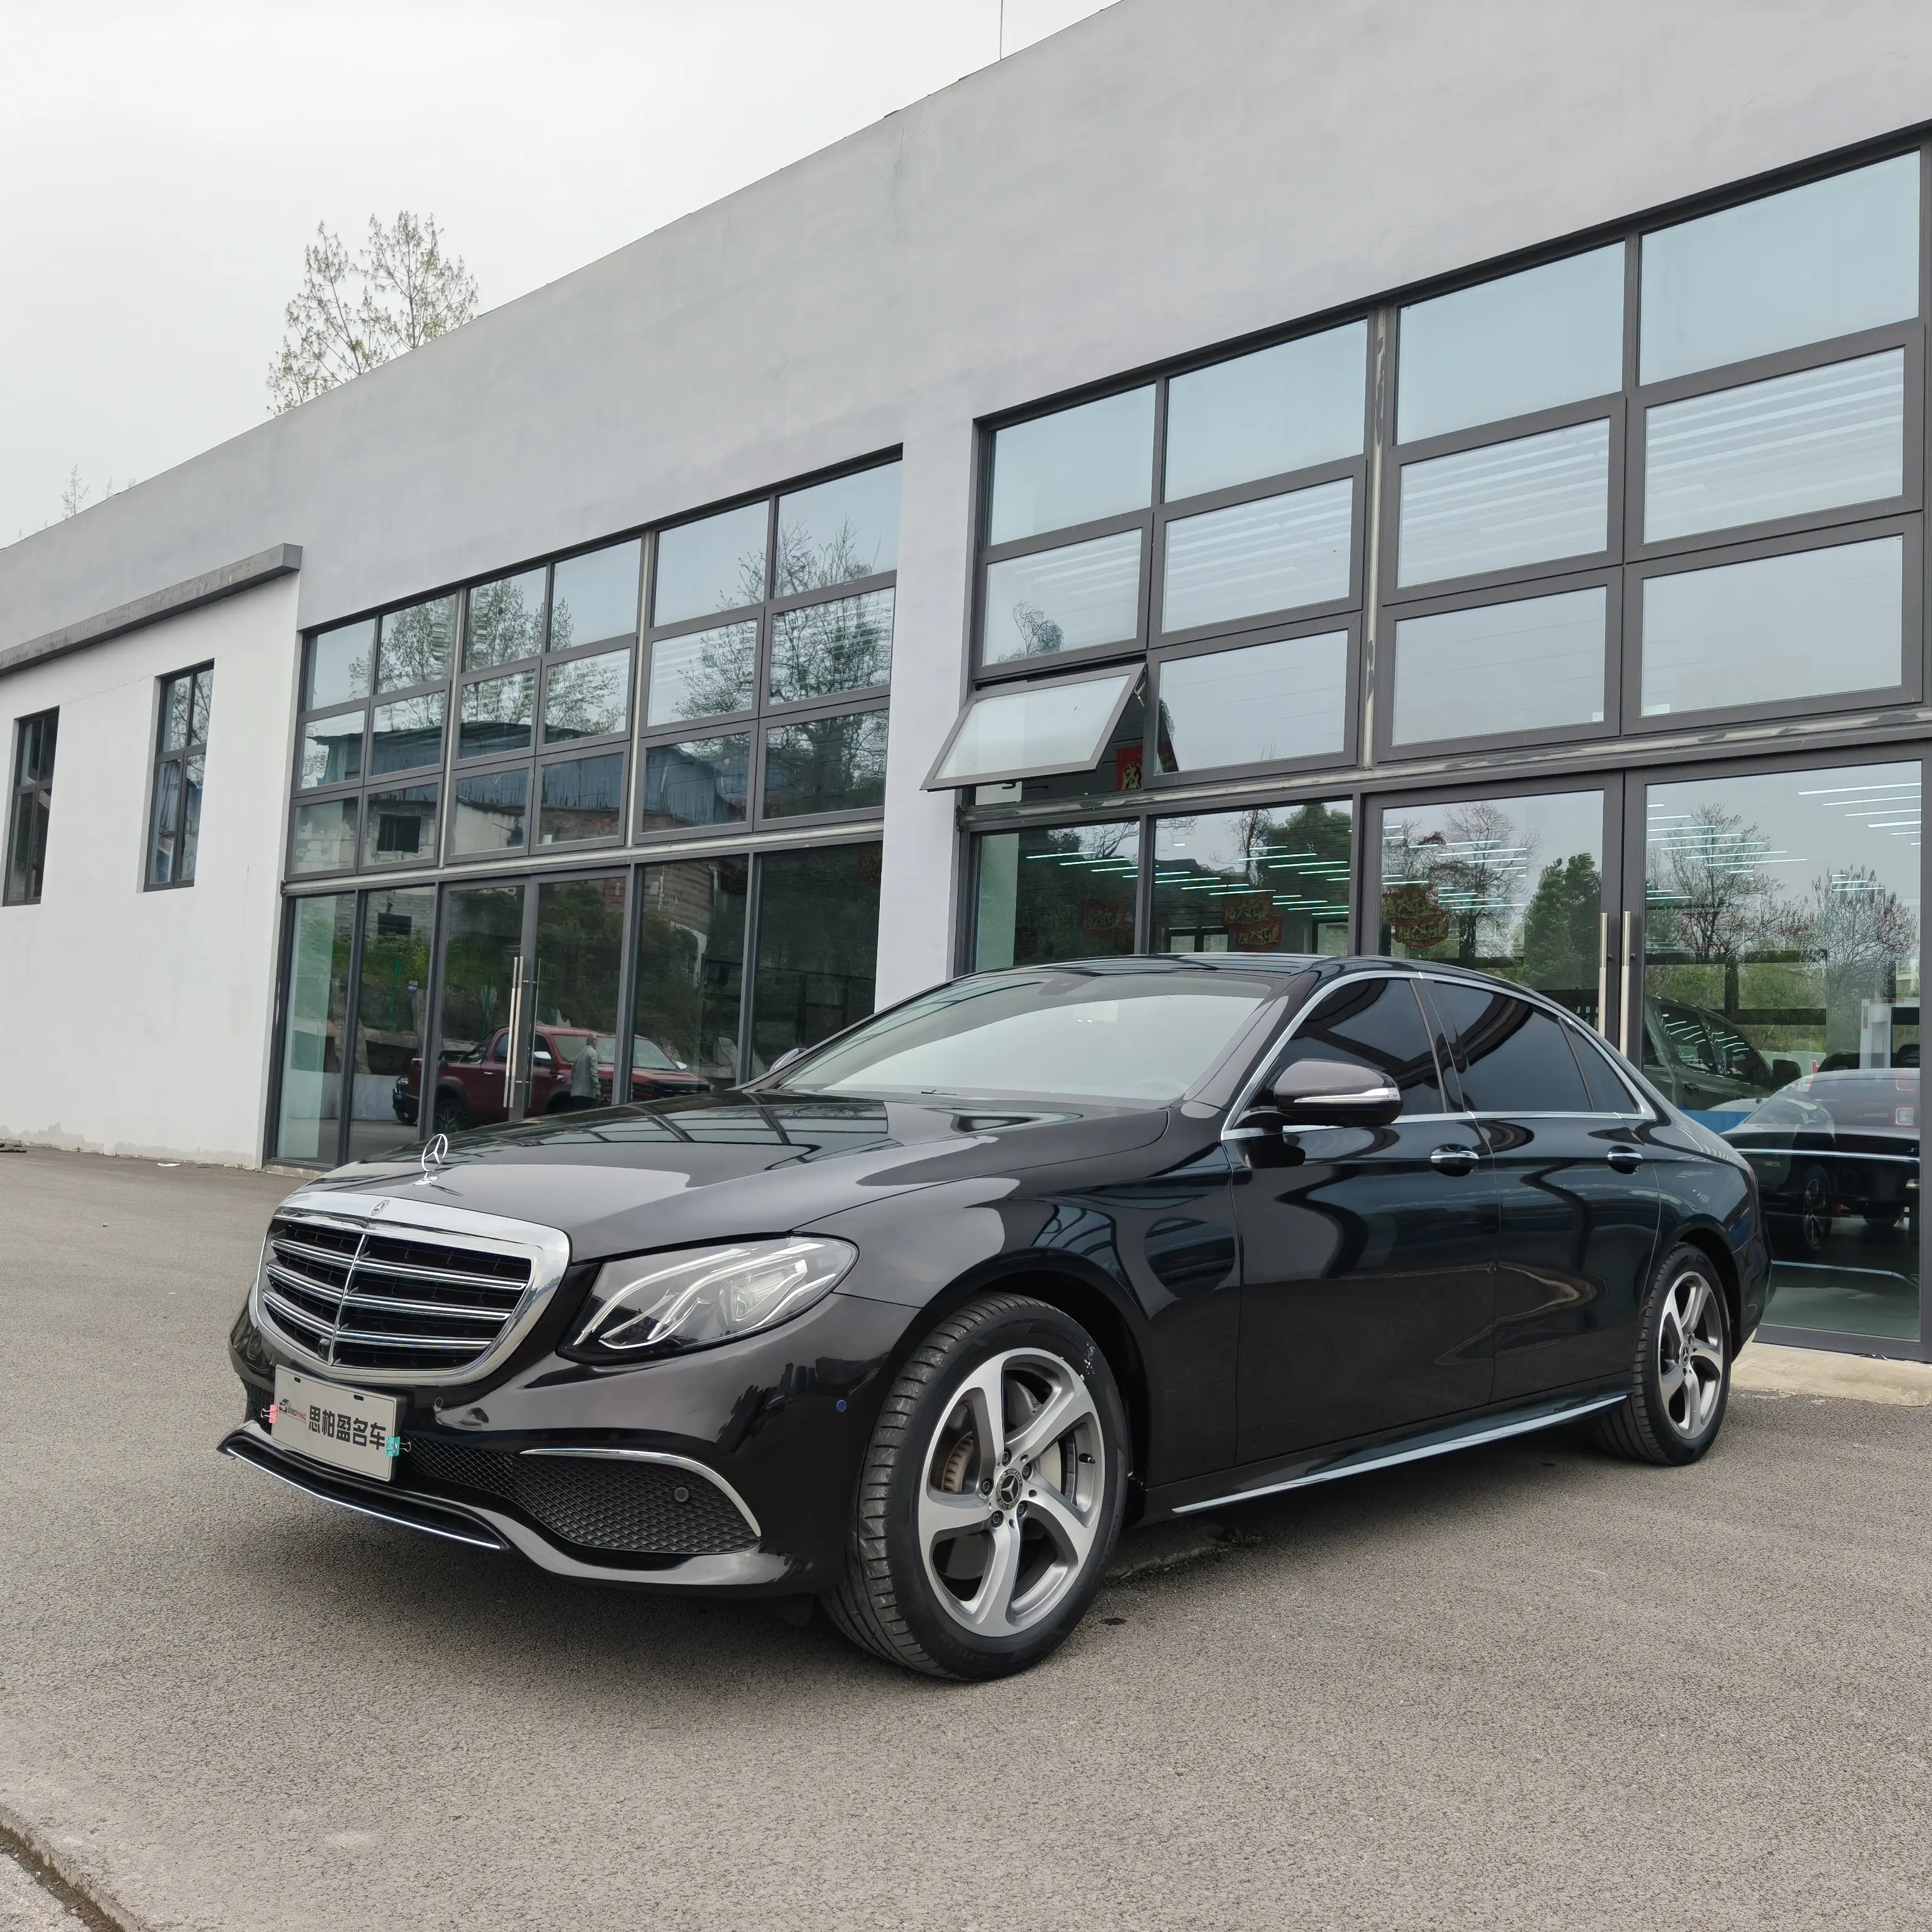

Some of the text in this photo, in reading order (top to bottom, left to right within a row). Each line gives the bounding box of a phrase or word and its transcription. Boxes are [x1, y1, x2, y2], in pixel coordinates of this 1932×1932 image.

[309, 1405, 386, 1450] 思柏盈名车
